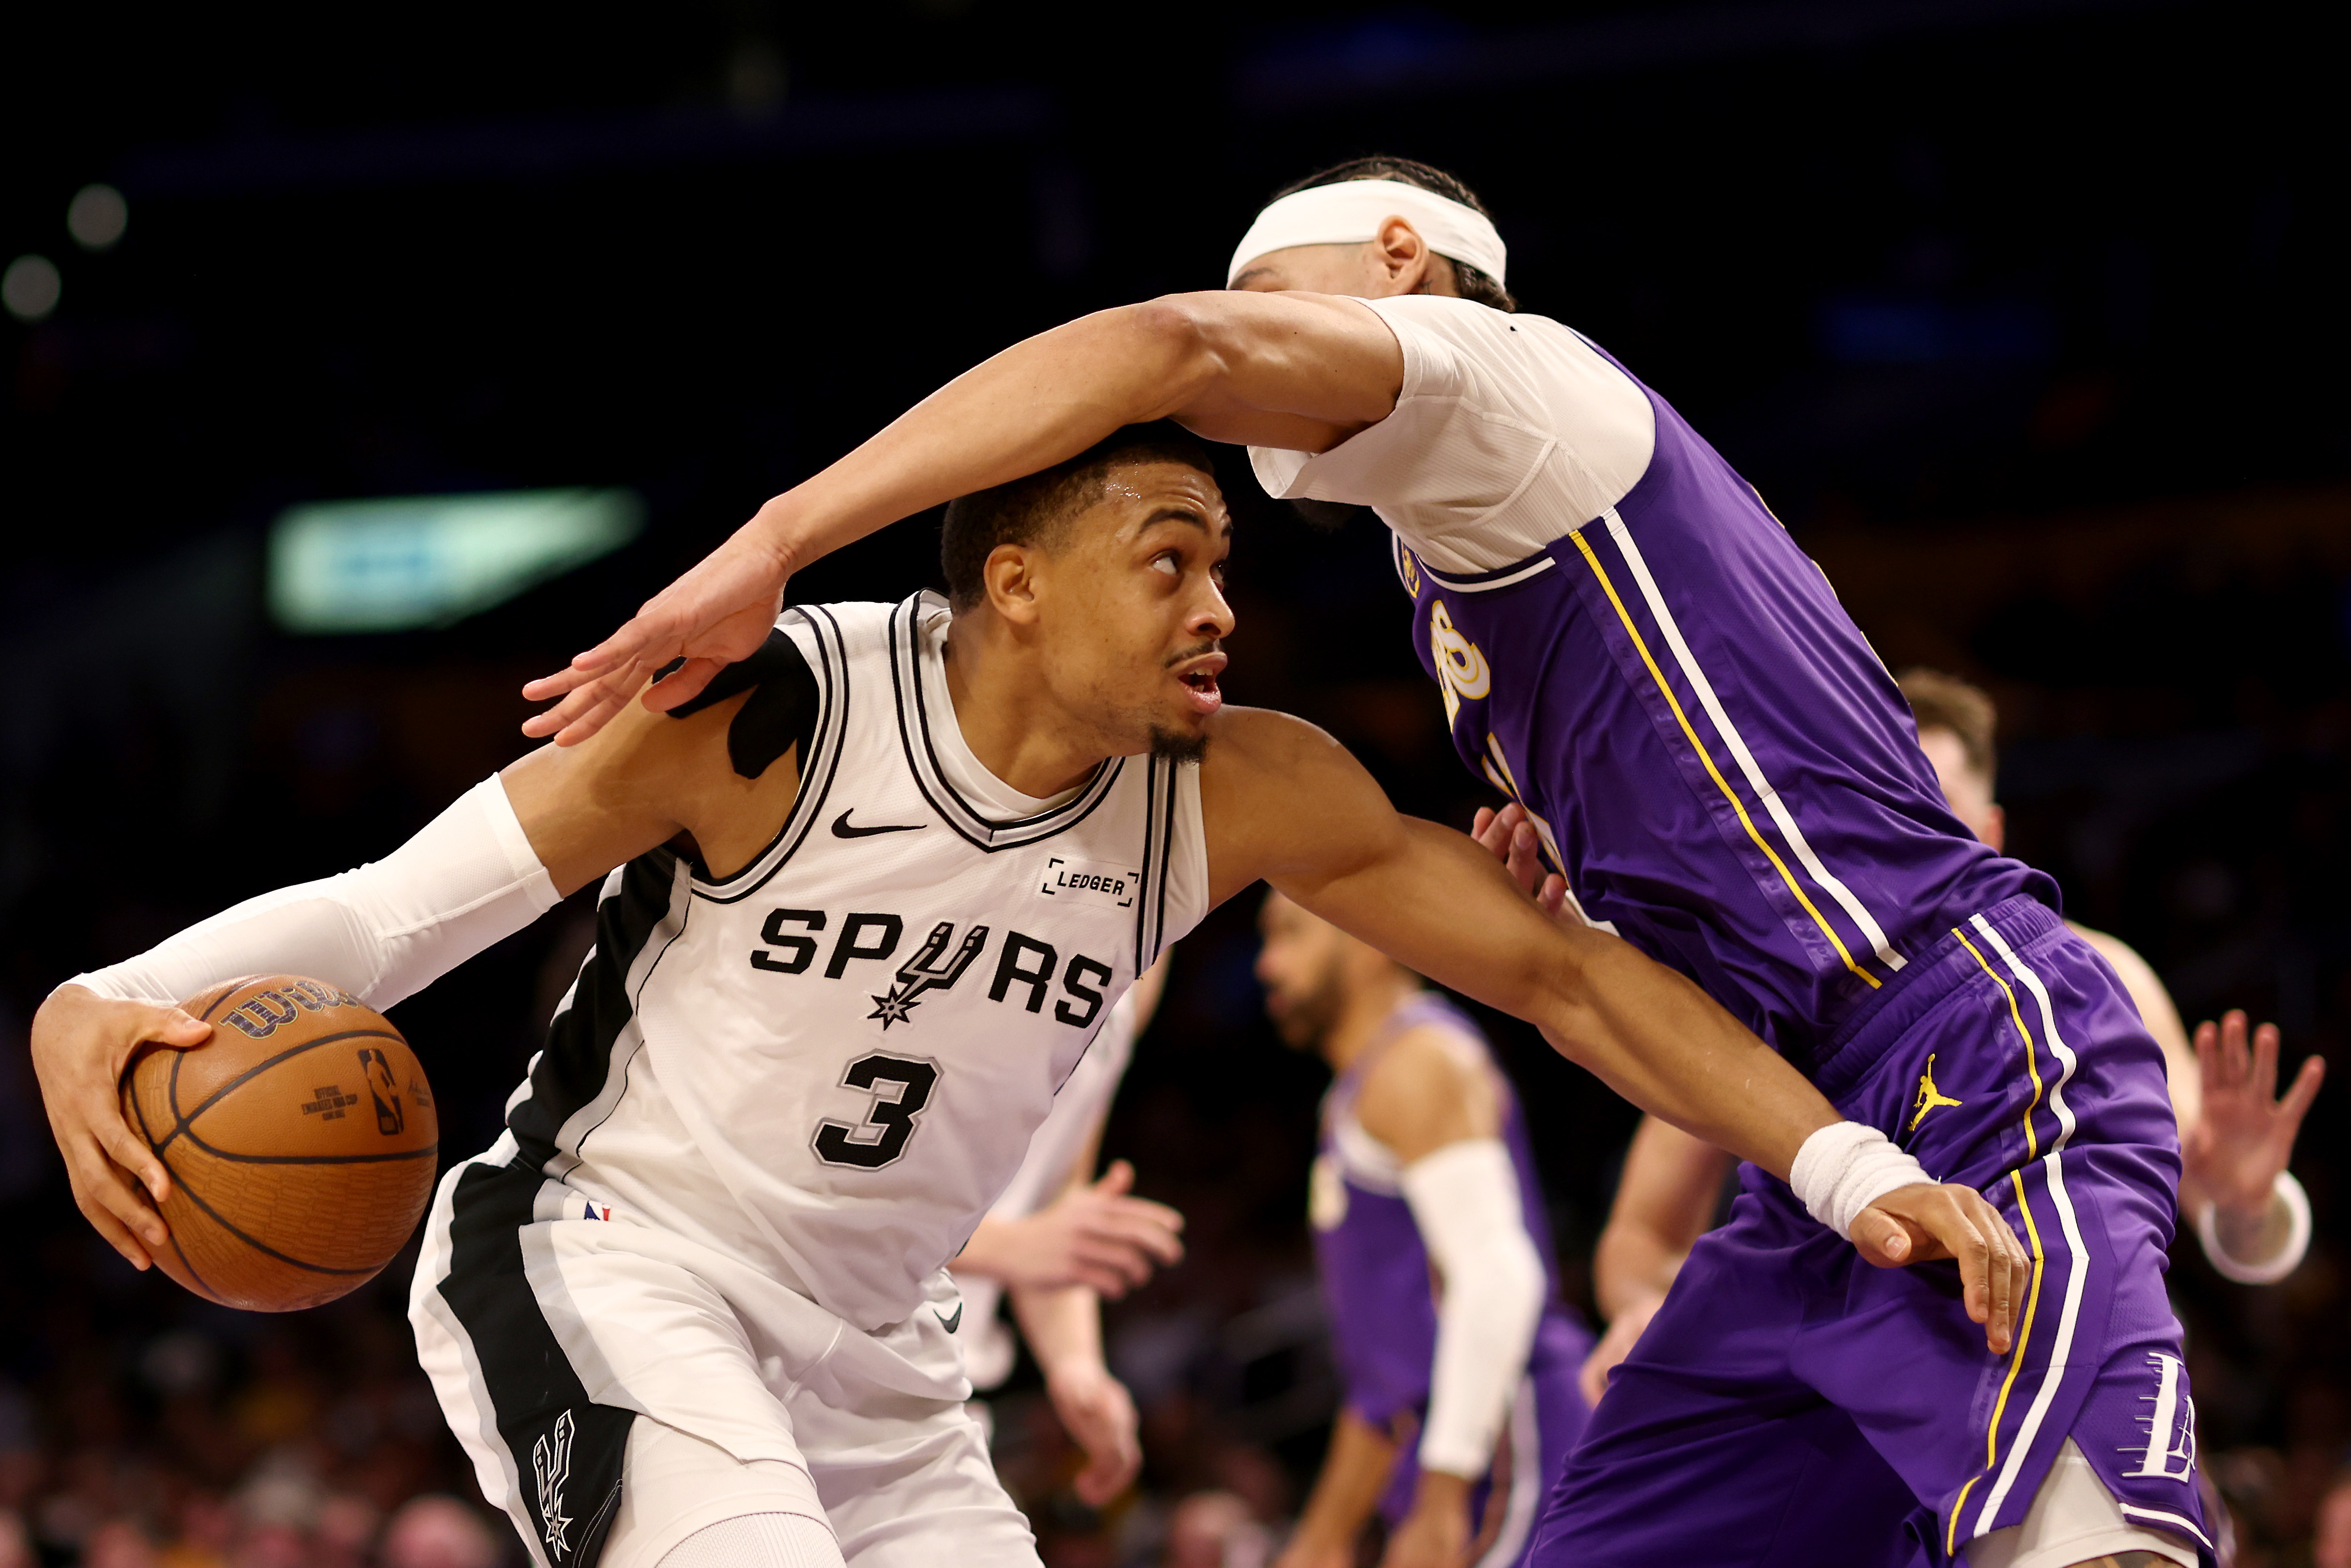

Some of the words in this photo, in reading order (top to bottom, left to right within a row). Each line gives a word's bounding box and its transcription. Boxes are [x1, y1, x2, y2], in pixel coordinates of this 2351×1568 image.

[1057, 871, 1125, 896] LEDGER
[749, 908, 1113, 1031] SPURS
[808, 1048, 944, 1173] 3
